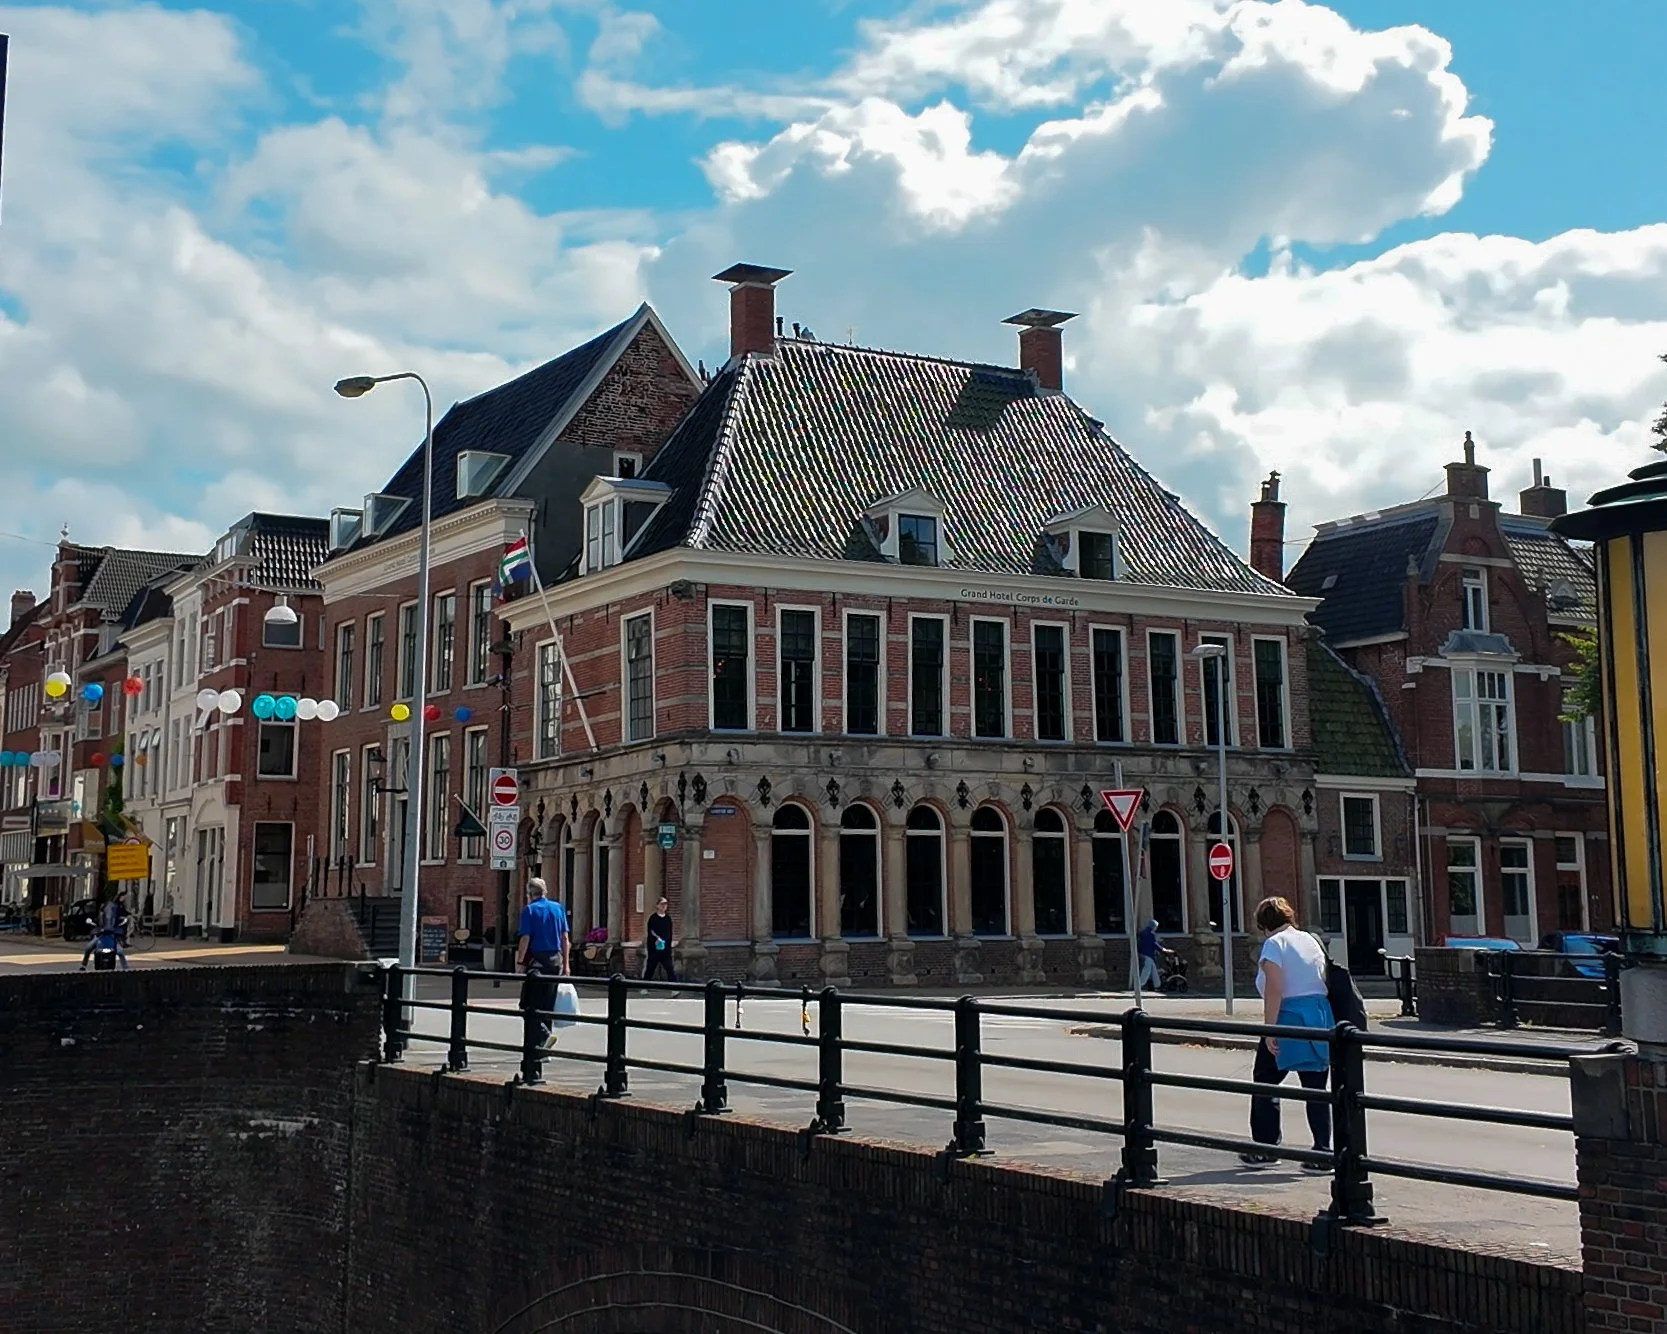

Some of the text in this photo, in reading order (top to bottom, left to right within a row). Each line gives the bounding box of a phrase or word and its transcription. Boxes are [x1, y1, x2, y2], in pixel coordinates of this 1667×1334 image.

[961, 589, 1079, 606] Grand Hotel Corps de Garde
[499, 836, 510, 845] 30
